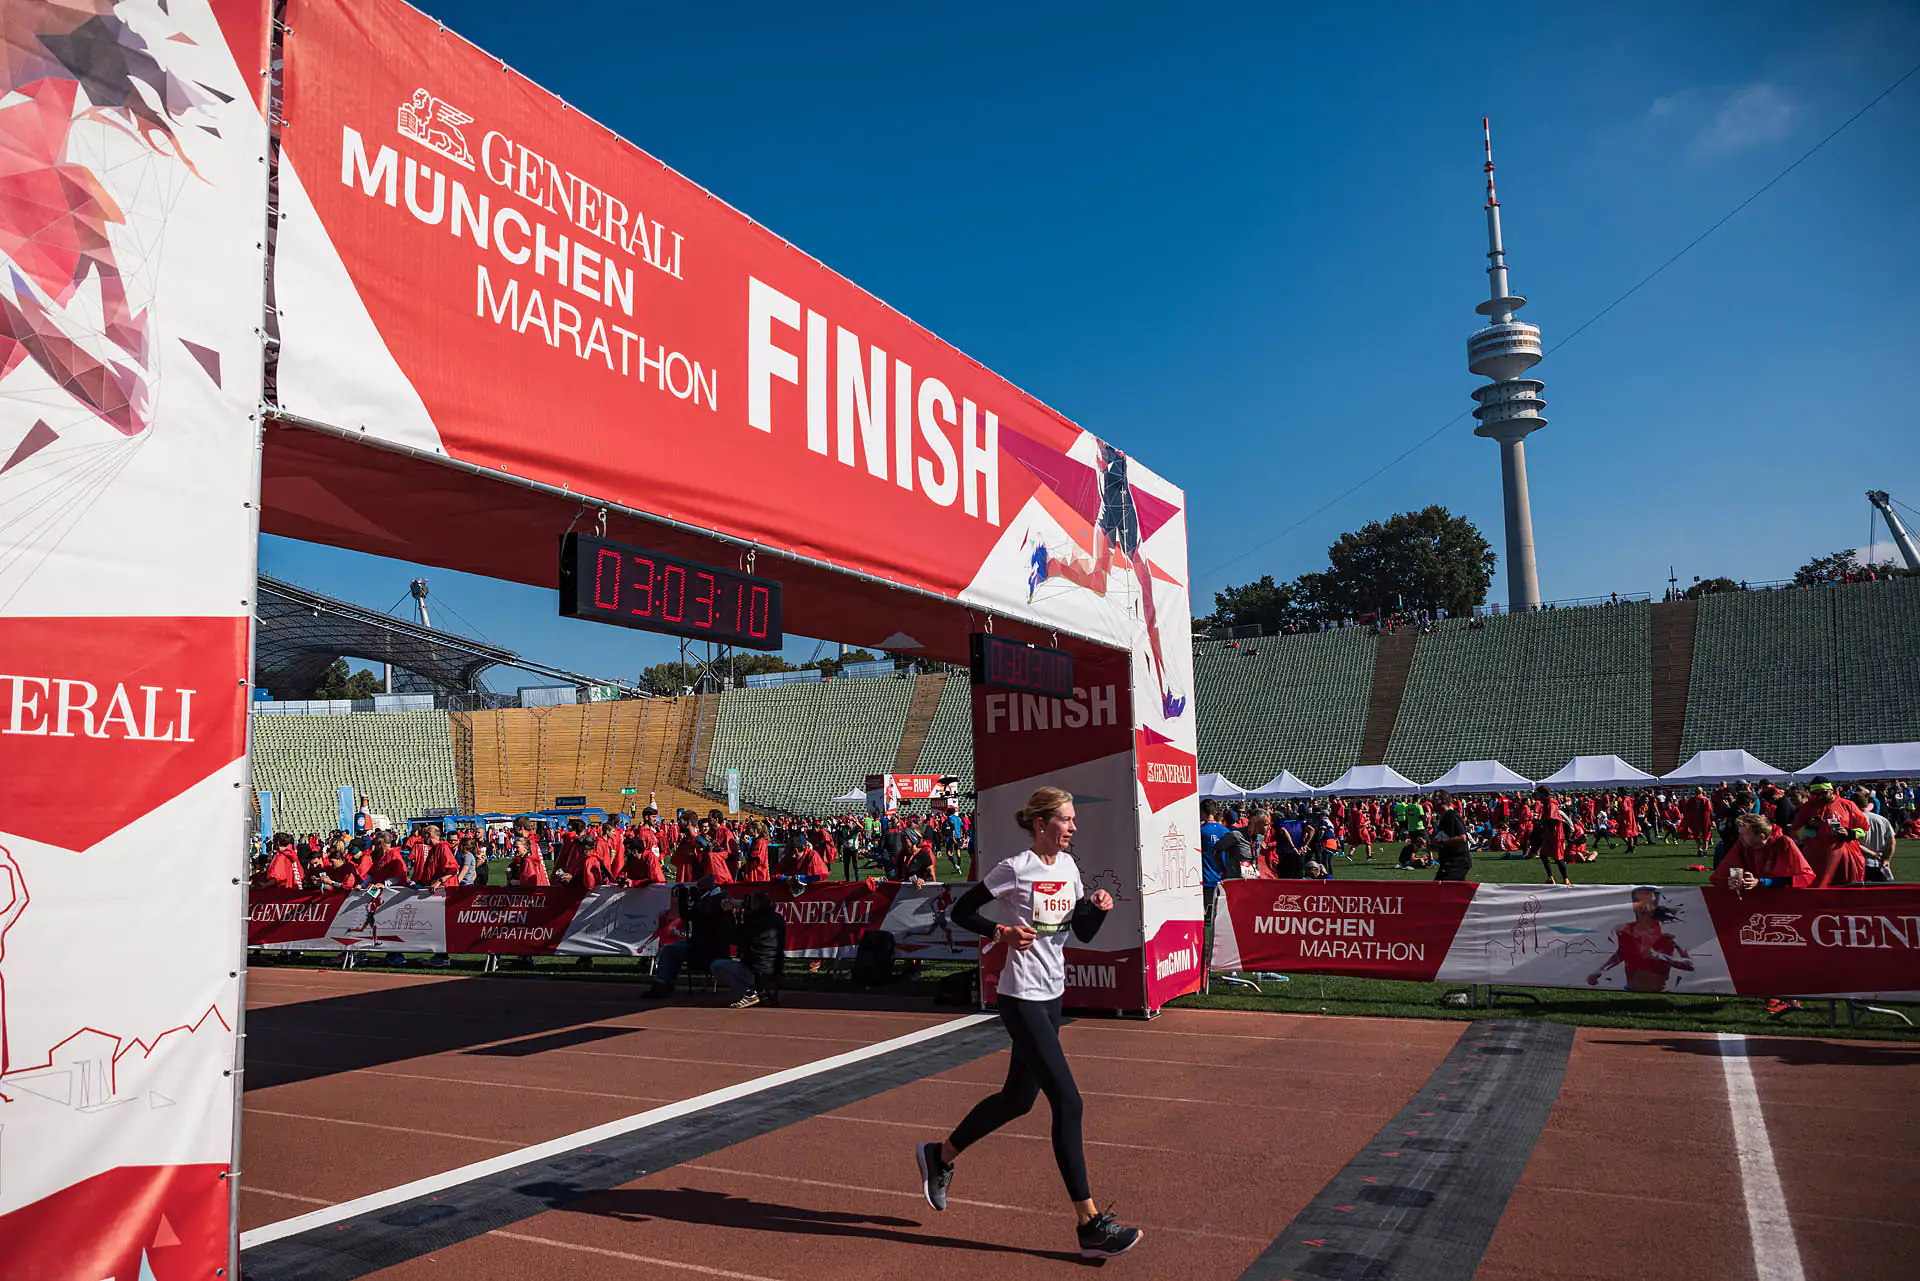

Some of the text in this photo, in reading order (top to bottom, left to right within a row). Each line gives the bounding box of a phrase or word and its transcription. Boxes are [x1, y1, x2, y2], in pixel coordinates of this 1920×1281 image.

[481, 131, 684, 280] GENERALI
[341, 125, 634, 316] MÜNCHEN
[475, 265, 717, 412] MARATHON
[748, 276, 1000, 527] FINISH
[594, 549, 769, 638] 03:03:10
[0, 675, 197, 743] ERALI
[986, 685, 1117, 733] FINISH
[913, 778, 932, 792] RUN!
[1153, 764, 1192, 784] GENERALI
[250, 903, 331, 922] GENERALI
[488, 895, 546, 908] GENERALI
[774, 900, 874, 924] ENERALI
[1043, 898, 1071, 912] 16151
[1303, 895, 1404, 915] GENERALI
[457, 910, 528, 924] MÜNCHEN
[1254, 915, 1375, 937] MÜNCHEN
[480, 926, 553, 941] MARATHON
[1300, 940, 1425, 962] MARATHON
[1065, 964, 1116, 989] GMM
